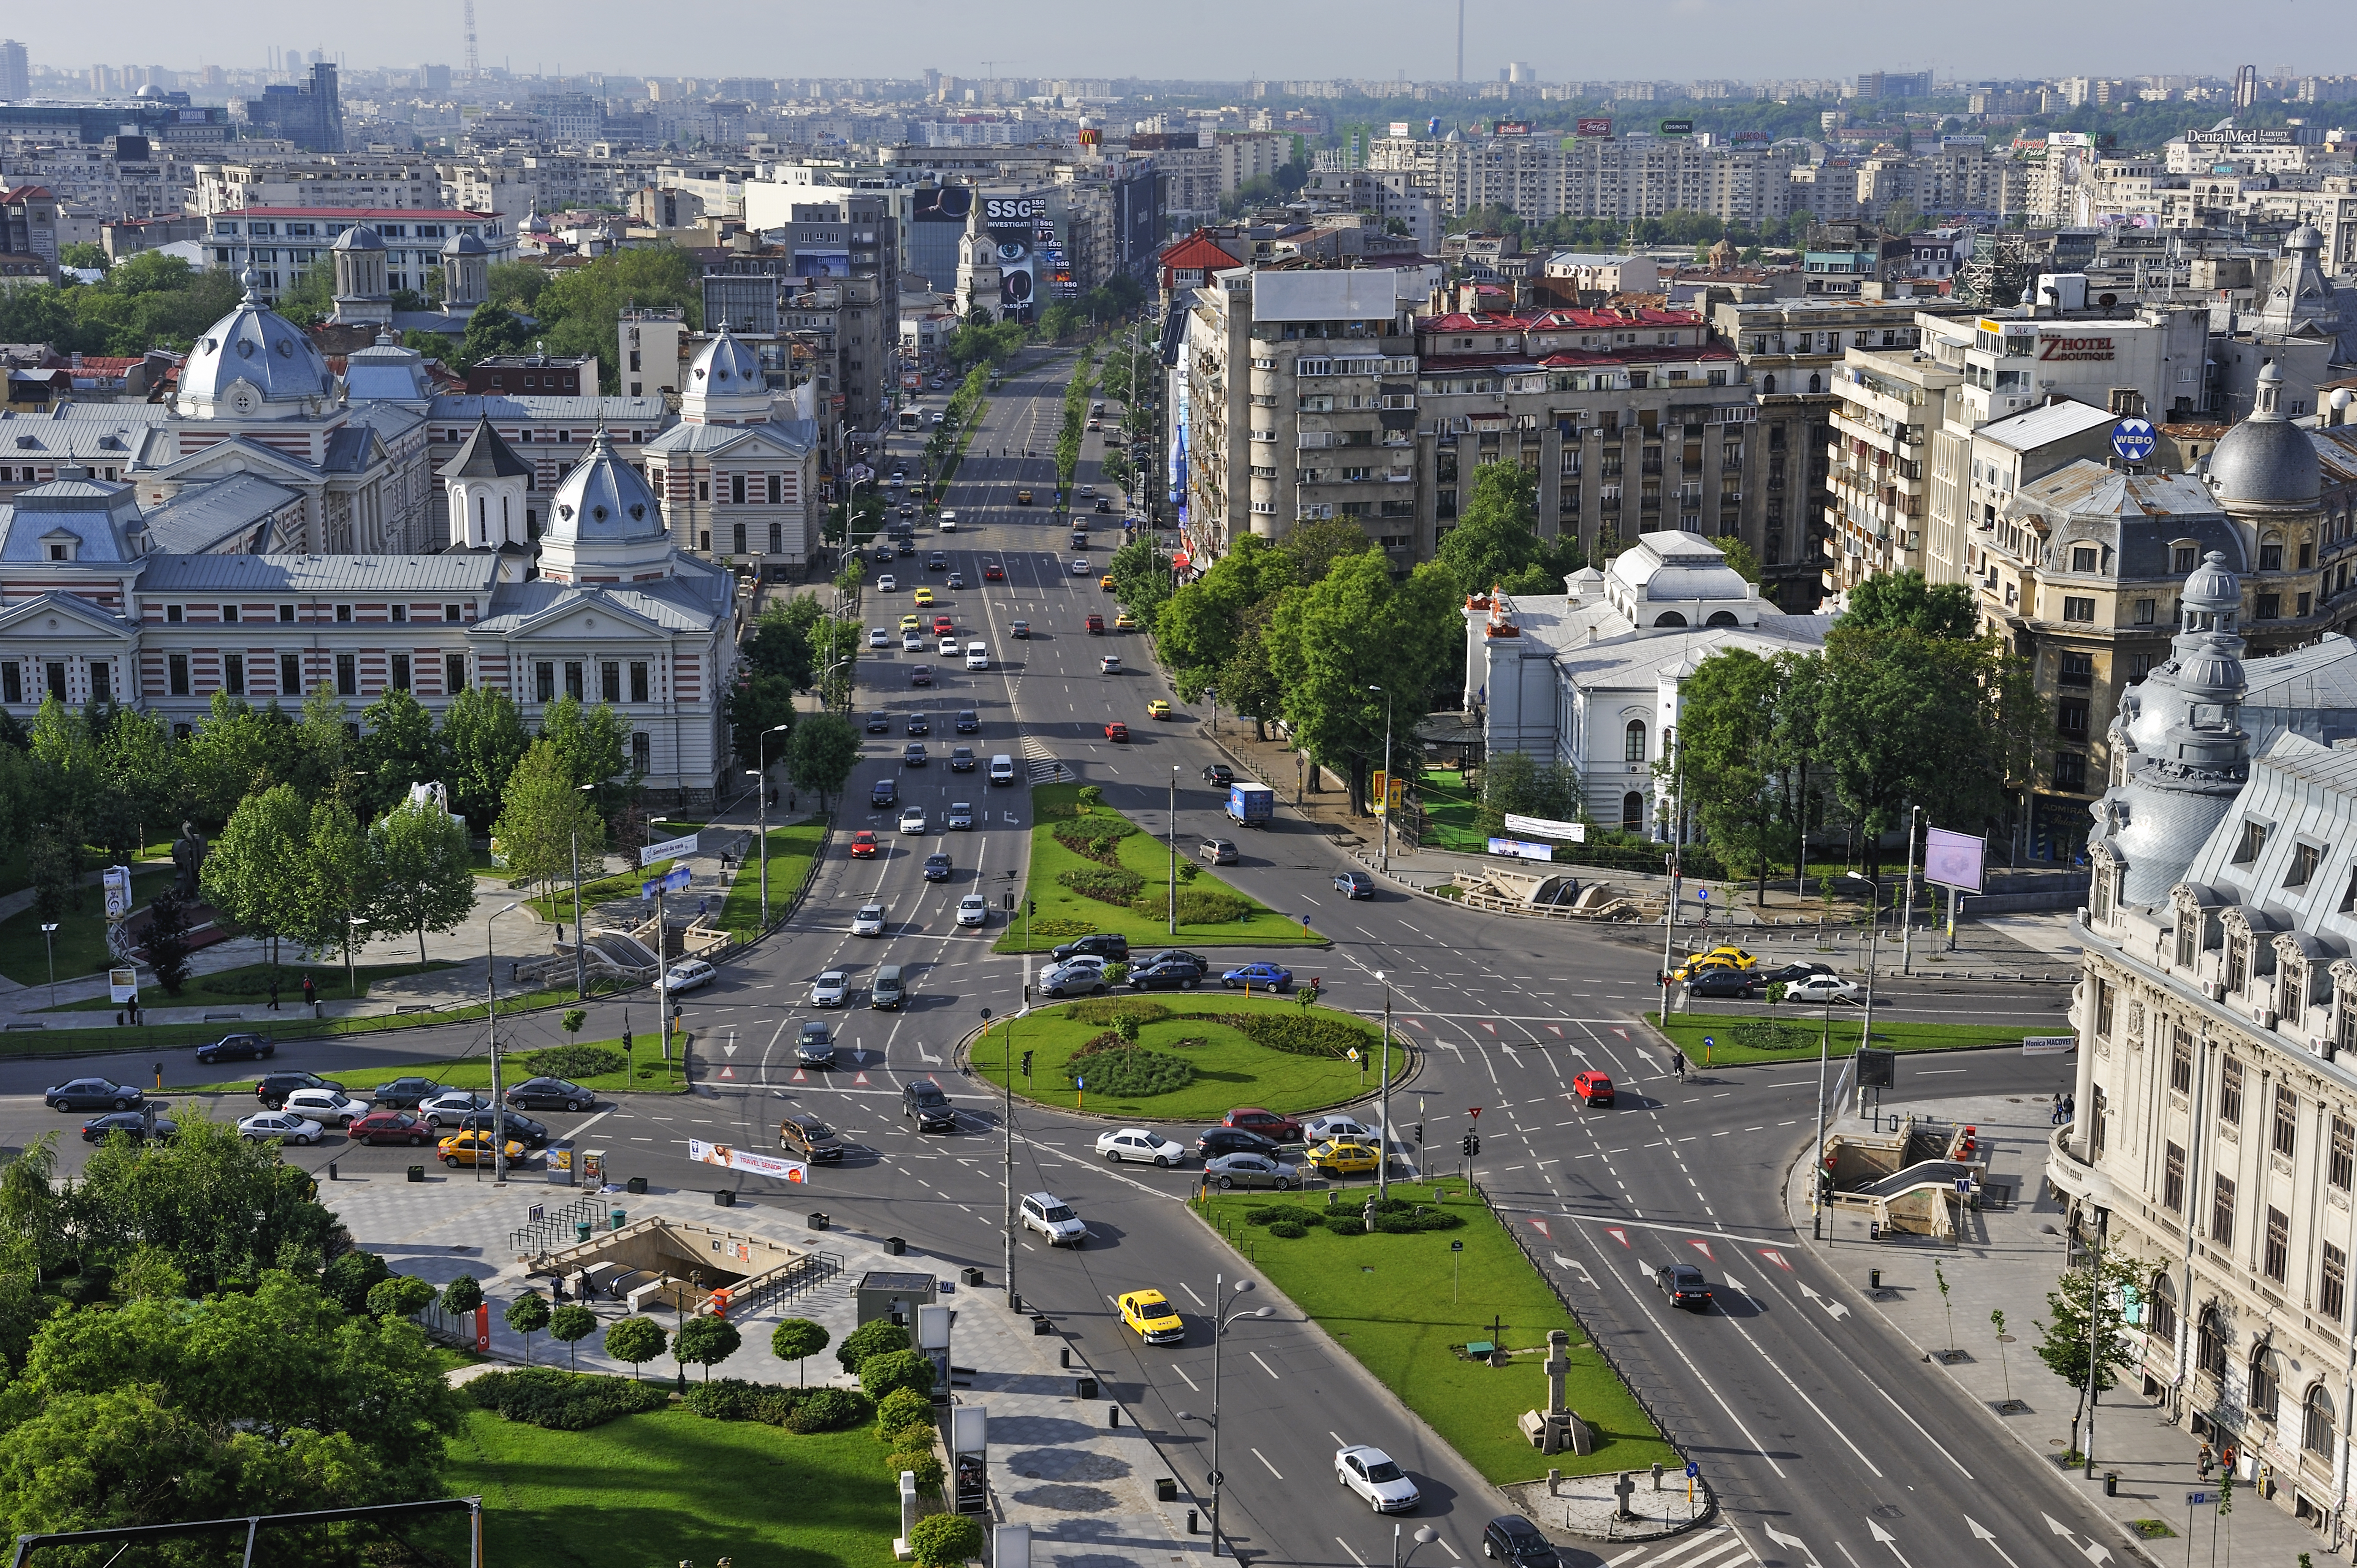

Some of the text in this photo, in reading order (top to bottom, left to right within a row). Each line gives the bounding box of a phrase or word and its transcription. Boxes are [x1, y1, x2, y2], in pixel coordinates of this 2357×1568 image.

[179, 111, 205, 120] SAMSUNG
[1735, 132, 1768, 140] LUKOIL
[2186, 130, 2257, 142] DentalMed
[2260, 130, 2288, 138] Luxury
[2013, 138, 2046, 149] Frutti
[987, 200, 1031, 217] SSG
[2061, 338, 2115, 350] HOTEL
[2060, 353, 2115, 361] BOUTIQUE
[2116, 435, 2153, 444] WEBO
[2042, 803, 2091, 817] ADMIRAL
[740, 1157, 760, 1167] TRAVEL
[761, 1162, 781, 1171] SENIOR
[1956, 1180, 1969, 1192] M
[533, 1207, 543, 1219] M
